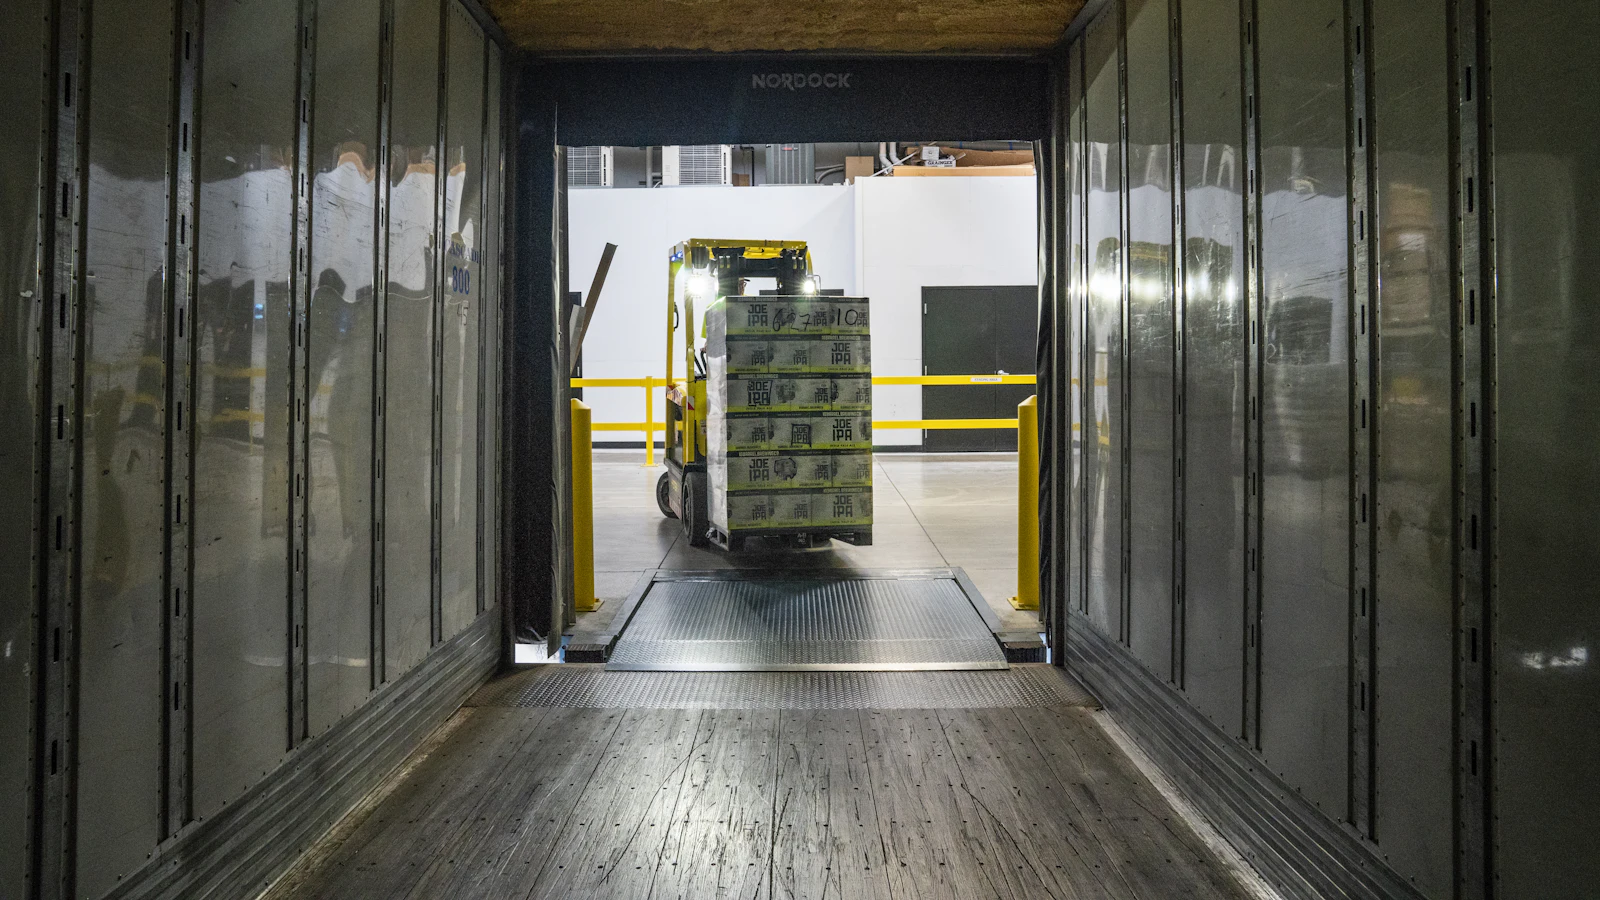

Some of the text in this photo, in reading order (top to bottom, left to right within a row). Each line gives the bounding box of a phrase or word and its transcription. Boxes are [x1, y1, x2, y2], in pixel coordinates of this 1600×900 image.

[752, 73, 850, 90] NORDOCK
[452, 265, 470, 295] 800
[748, 304, 768, 314] JOE
[748, 315, 768, 326] IPA
[837, 308, 859, 325] 10
[831, 343, 851, 352] JOE
[752, 358, 766, 366] IPA
[793, 357, 807, 365] IPA
[831, 353, 851, 364] IPA
[748, 381, 769, 391] JOE
[748, 392, 769, 404] IPA
[815, 395, 828, 403] IPA
[856, 395, 869, 403] IPA
[833, 419, 852, 428] JOE
[752, 434, 766, 442] IPA
[833, 429, 852, 441] IPA
[749, 458, 769, 468] JOE
[749, 469, 769, 481] IPA
[815, 472, 828, 480] IPA
[833, 495, 852, 504] JOE
[752, 512, 766, 520] IPA
[794, 511, 807, 519] IPA
[833, 505, 853, 517] IPA
